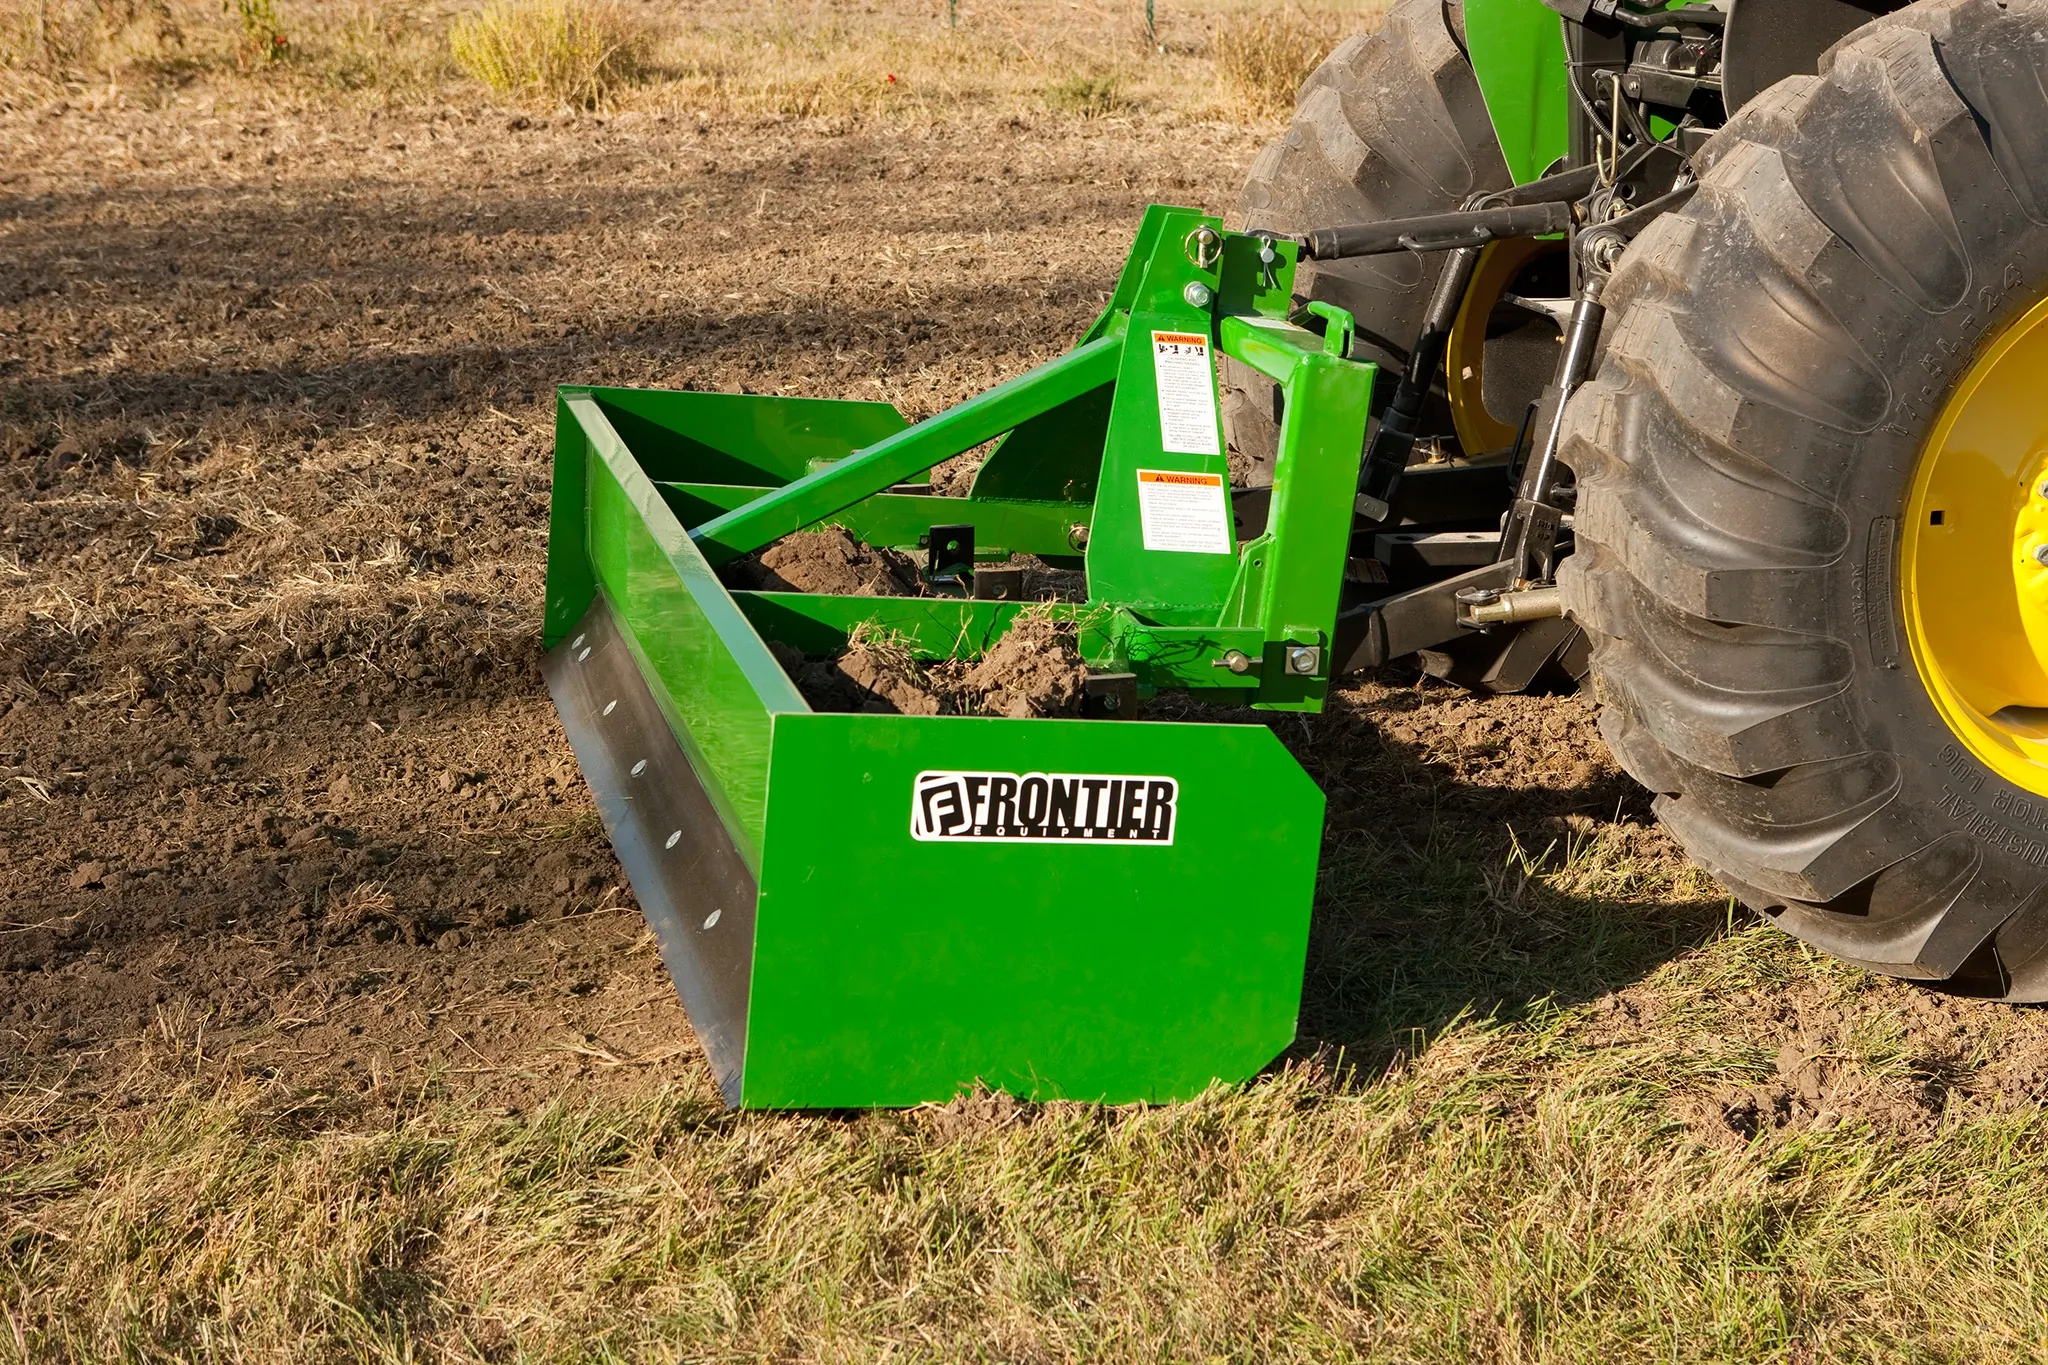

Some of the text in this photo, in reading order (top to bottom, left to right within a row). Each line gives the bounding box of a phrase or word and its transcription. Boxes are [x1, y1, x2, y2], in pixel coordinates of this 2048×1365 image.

[1167, 335, 1202, 345] WARNING
[1166, 475, 1208, 485] WARNING
[1937, 743, 1987, 794] LUG
[970, 776, 1175, 829] FRONTIER
[973, 826, 1161, 839] EQUIPMENT
